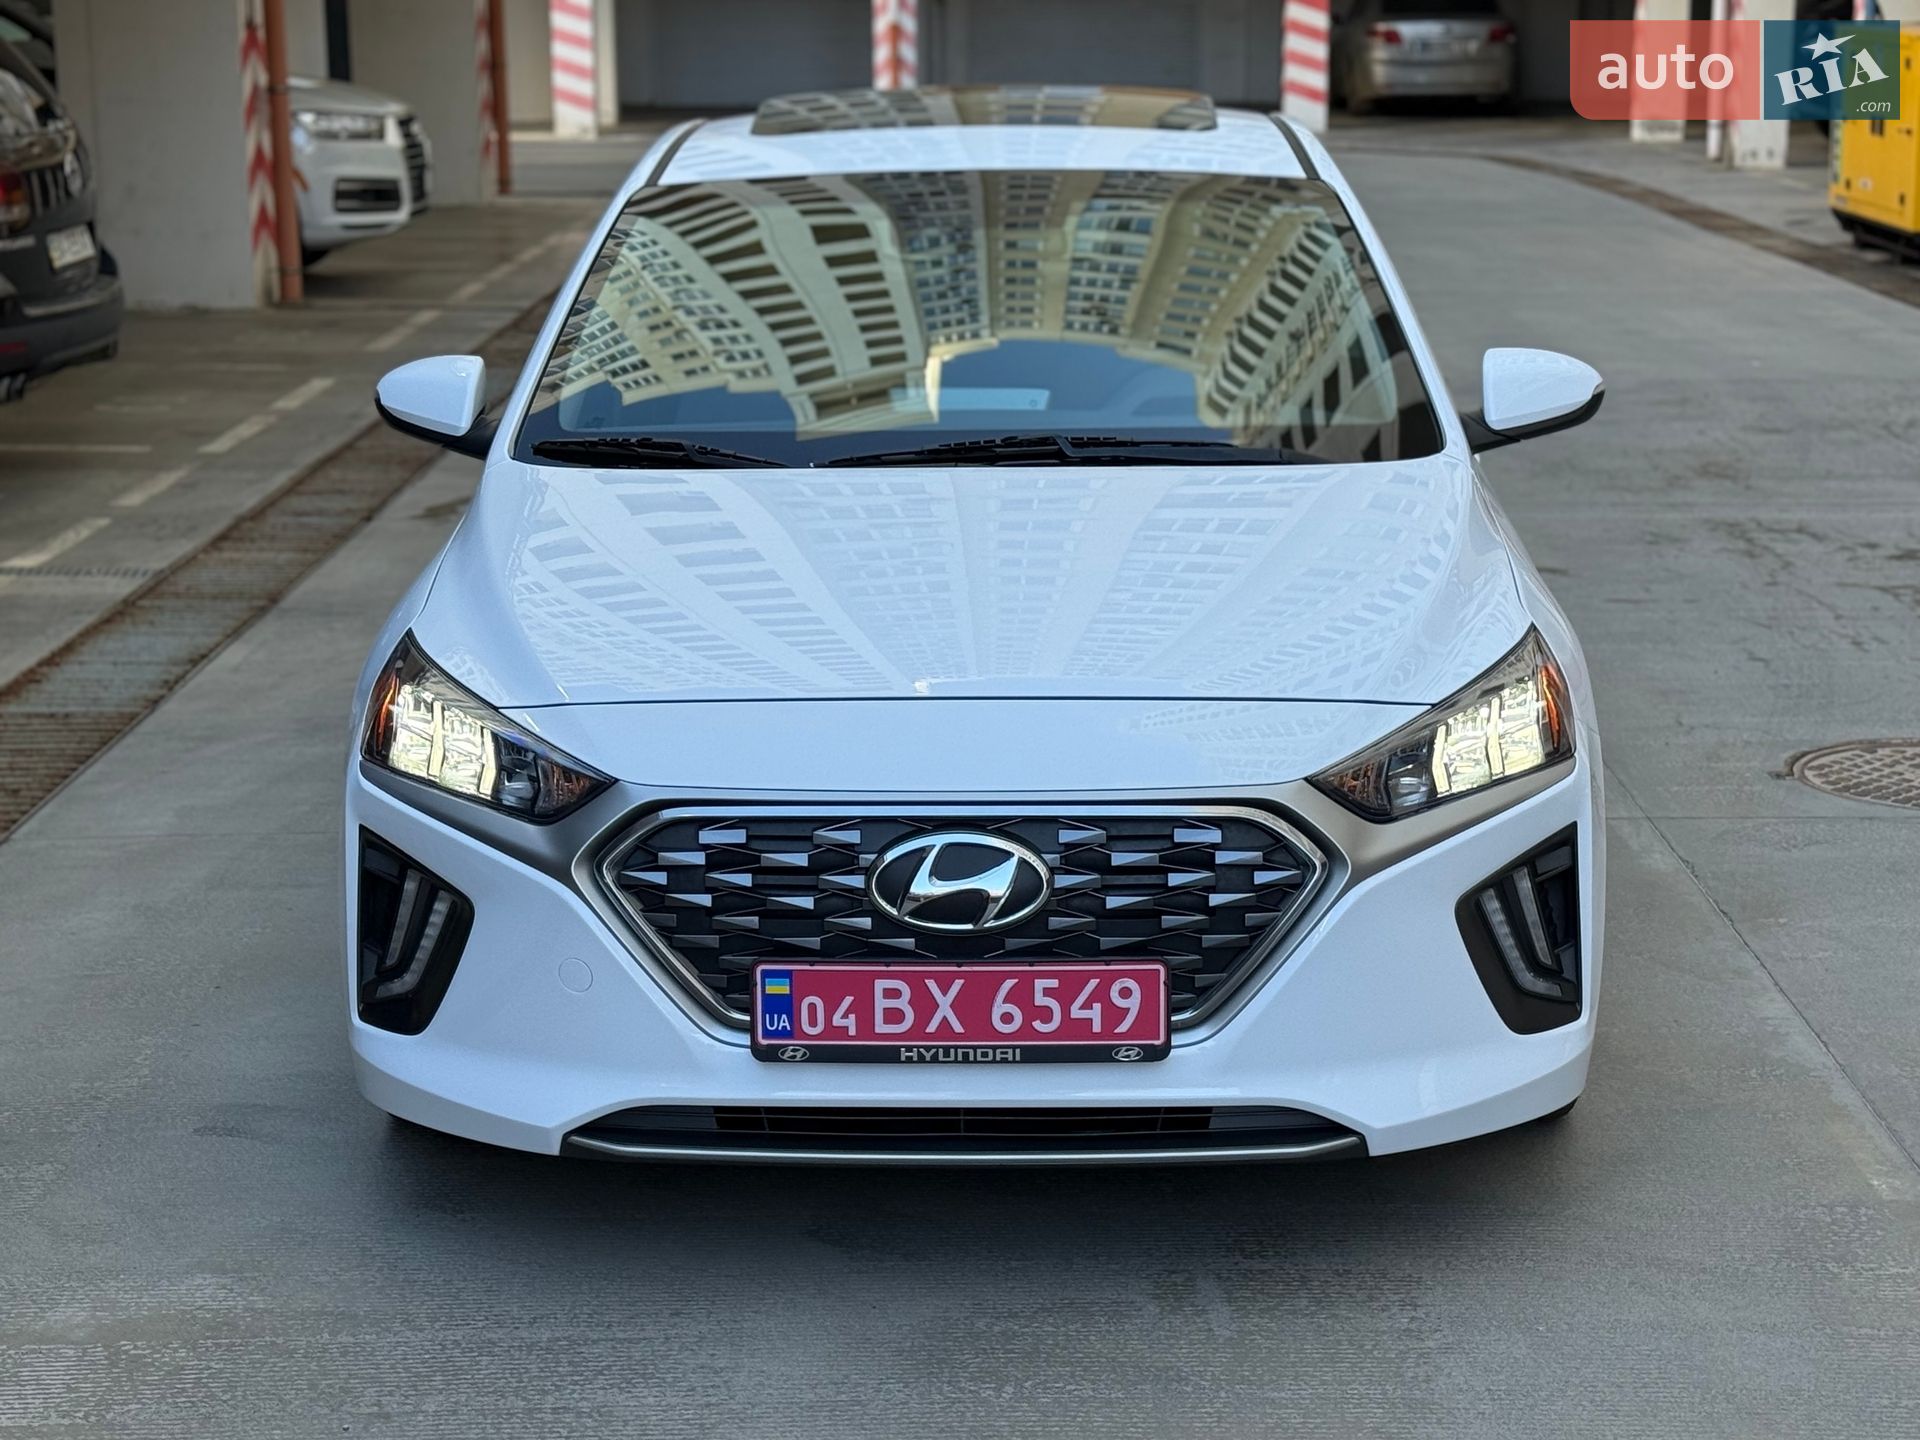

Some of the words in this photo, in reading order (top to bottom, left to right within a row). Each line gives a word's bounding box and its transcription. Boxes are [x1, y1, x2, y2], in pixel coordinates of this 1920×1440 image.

[801, 995, 857, 1036] 04
[873, 978, 965, 1035] BX
[990, 978, 1143, 1035] 6549
[765, 1013, 791, 1031] UA
[899, 1047, 1021, 1062] HYUNDAI
